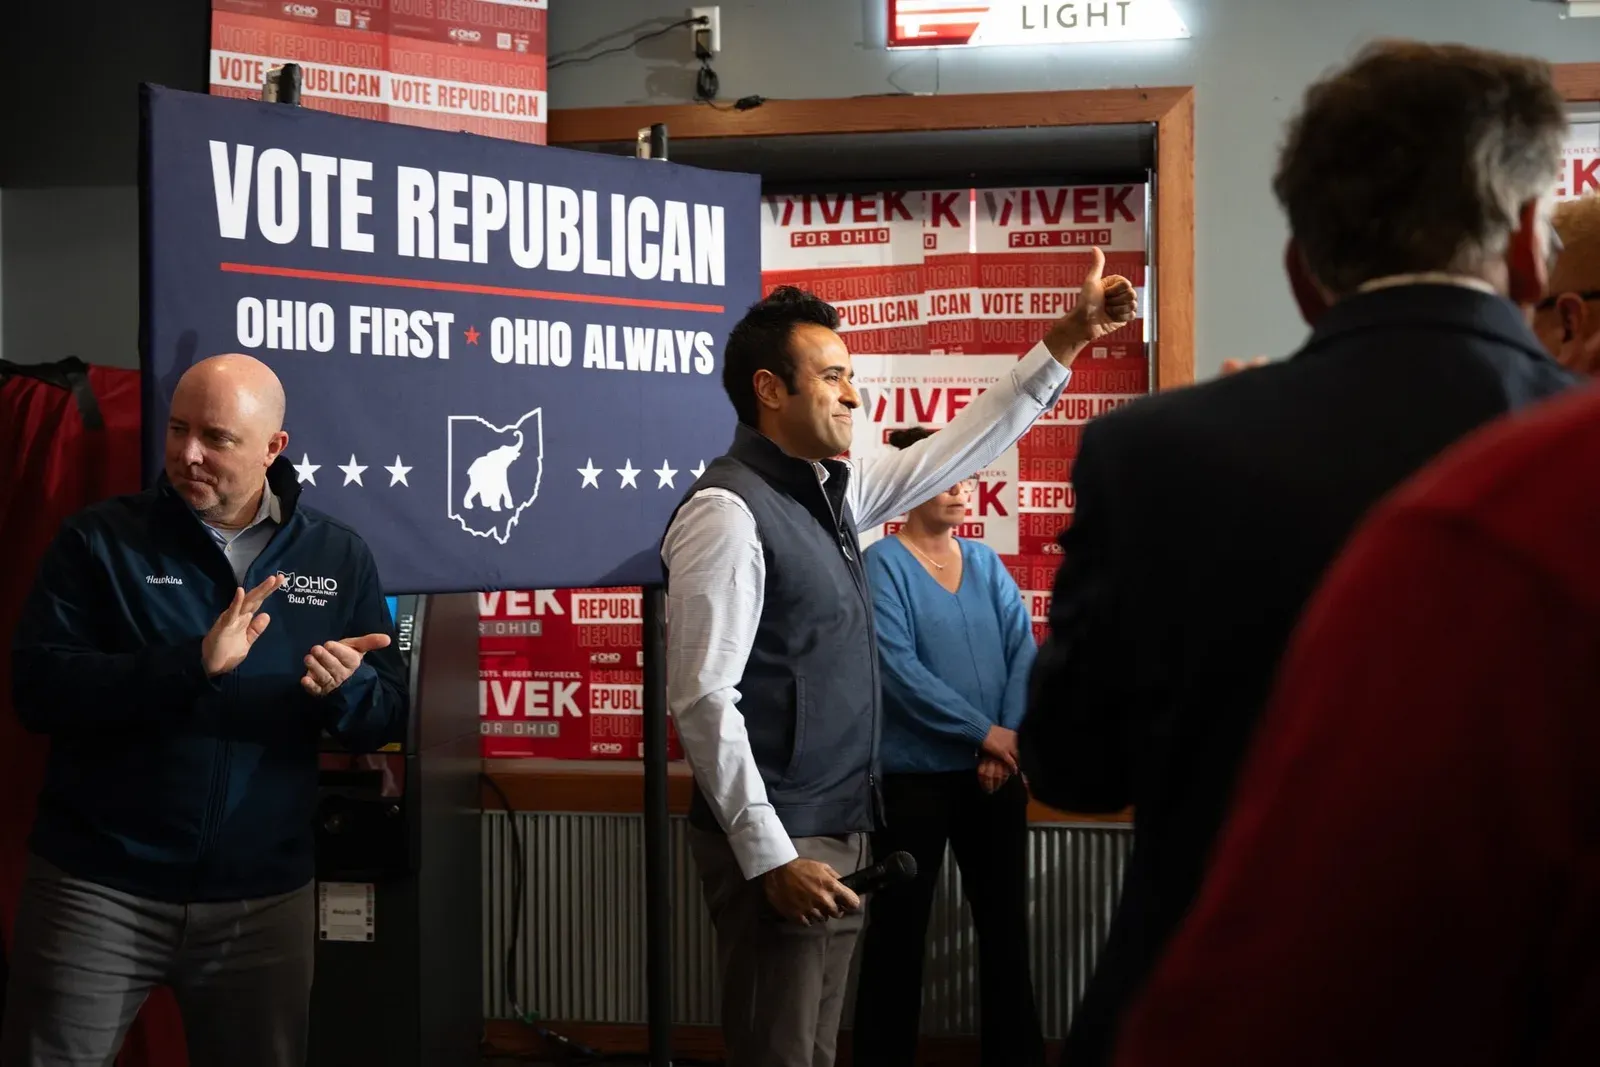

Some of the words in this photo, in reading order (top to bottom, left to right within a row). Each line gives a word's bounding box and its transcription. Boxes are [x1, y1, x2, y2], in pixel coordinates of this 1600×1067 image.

[1022, 1, 1131, 29] LIGHT
[219, 25, 265, 52] VOTE
[271, 33, 382, 67] REPUBLICAN
[219, 56, 263, 84] VOTE
[271, 63, 381, 98] UBLICAN
[391, 48, 433, 77] VOTE
[437, 55, 540, 89] REPUBLICAN
[391, 79, 432, 105] VOTE
[437, 85, 539, 117] REPUBLICAN
[209, 140, 375, 253] VOTE
[397, 165, 725, 286] REPUBLICAN
[765, 190, 913, 226] VIVEK
[984, 186, 1136, 227] VIVEK
[793, 232, 830, 246] FOR
[841, 230, 889, 243] OHIO
[1012, 232, 1049, 246] FOR
[1061, 231, 1109, 244] OHIO
[982, 264, 1025, 287] VOTE
[838, 299, 919, 326] PUBLICAN
[982, 293, 1024, 314] VOTE
[1030, 293, 1077, 314] REPU
[236, 296, 335, 353] OHIO
[349, 305, 454, 360] FIRST
[490, 316, 572, 367] OHIO
[583, 323, 714, 375] ALWAYS
[982, 320, 1025, 344] VOTE
[858, 376, 886, 384] LOWER
[922, 376, 953, 384] BIGGER
[859, 387, 987, 423] VIVE
[1031, 487, 1075, 508] REPU
[952, 526, 982, 537] HIO
[145, 574, 183, 585] Hawkins
[295, 575, 338, 591] OHIO
[287, 593, 305, 604] Bus
[306, 595, 328, 607] Tour
[478, 590, 565, 616] VEK
[495, 622, 540, 635] OHIO
[503, 671, 532, 679] BIGGER
[534, 671, 583, 679] PAYCHECKS.
[479, 680, 583, 717] IVEK
[591, 688, 643, 710] EPUBL
[480, 722, 503, 734] OR
[513, 723, 559, 736] OHIO
